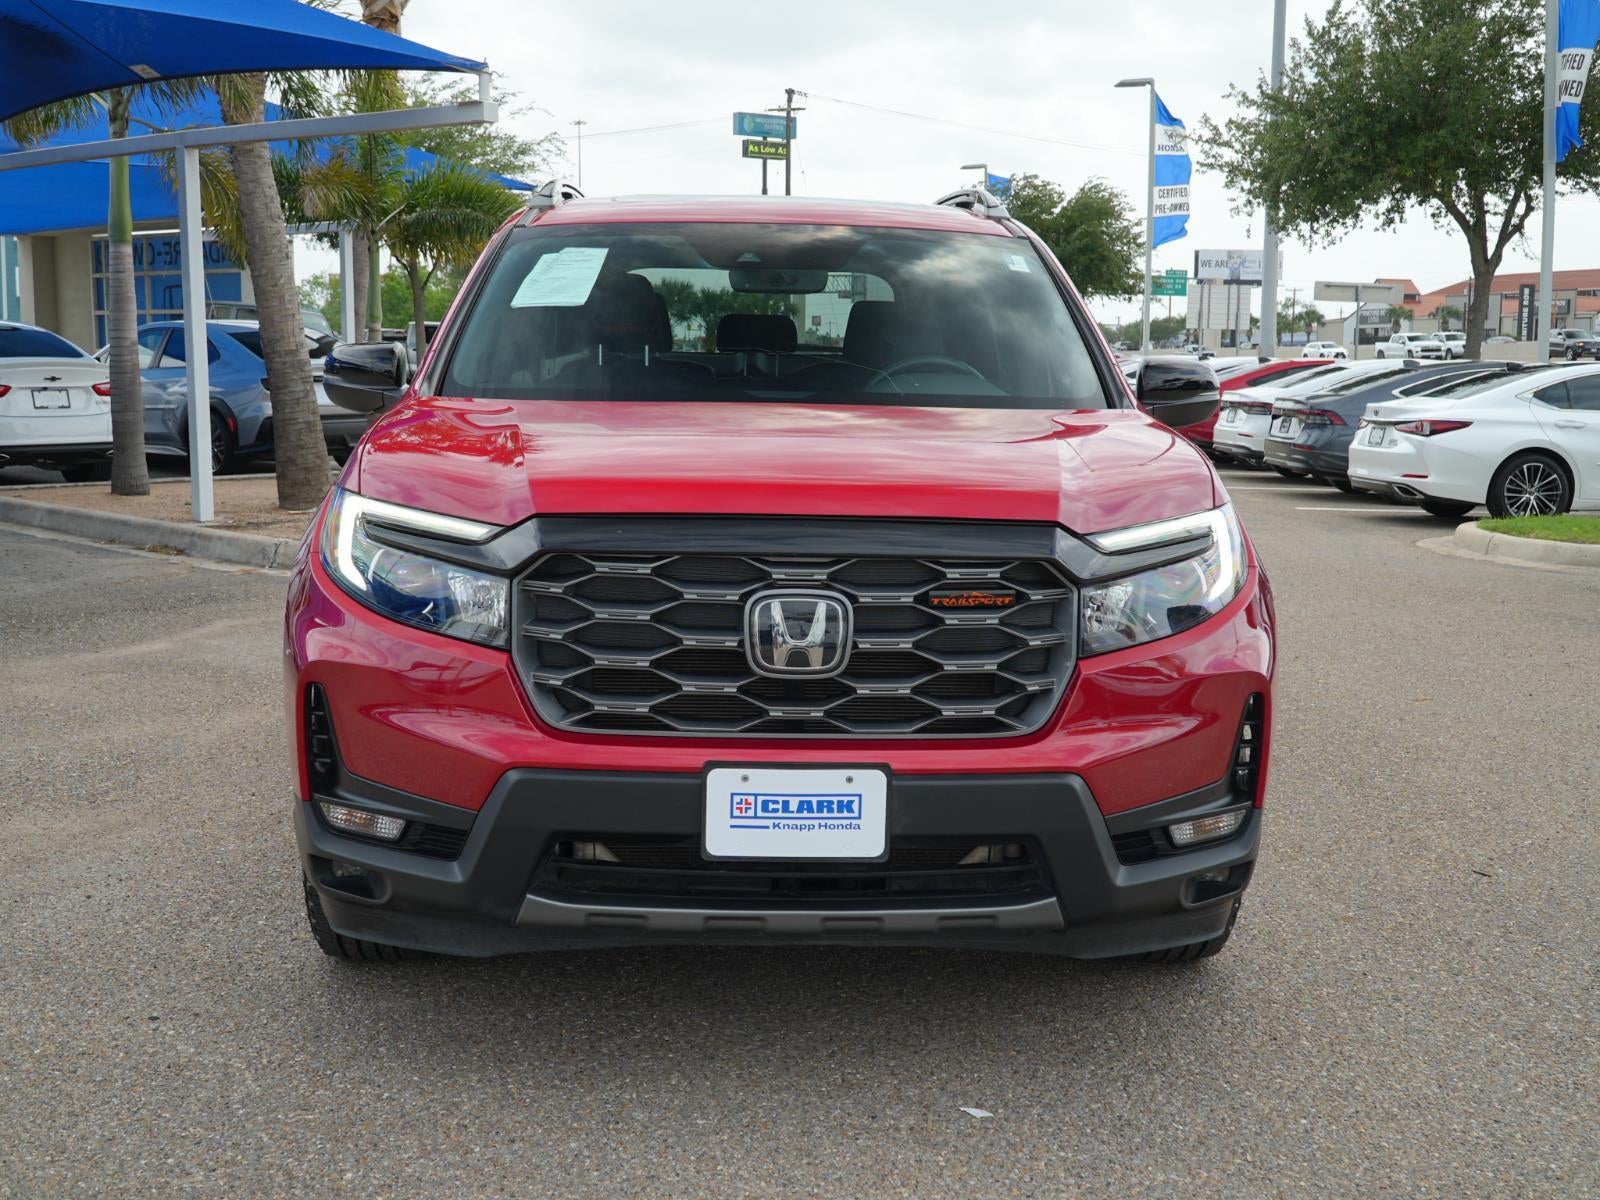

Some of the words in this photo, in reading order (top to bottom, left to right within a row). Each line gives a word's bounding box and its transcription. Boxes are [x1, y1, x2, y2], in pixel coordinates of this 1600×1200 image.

[749, 144, 759, 153] As
[761, 145, 776, 154] Low
[1158, 187, 1188, 199] CERTIFIED
[1154, 202, 1190, 214] PRE-OWNED
[1200, 259, 1213, 269] WE
[1214, 259, 1230, 269] ARE
[931, 595, 1014, 607] TRAILSPORT
[760, 799, 855, 814] CLARK
[772, 821, 816, 832] Knapp
[818, 821, 861, 831] Honda
